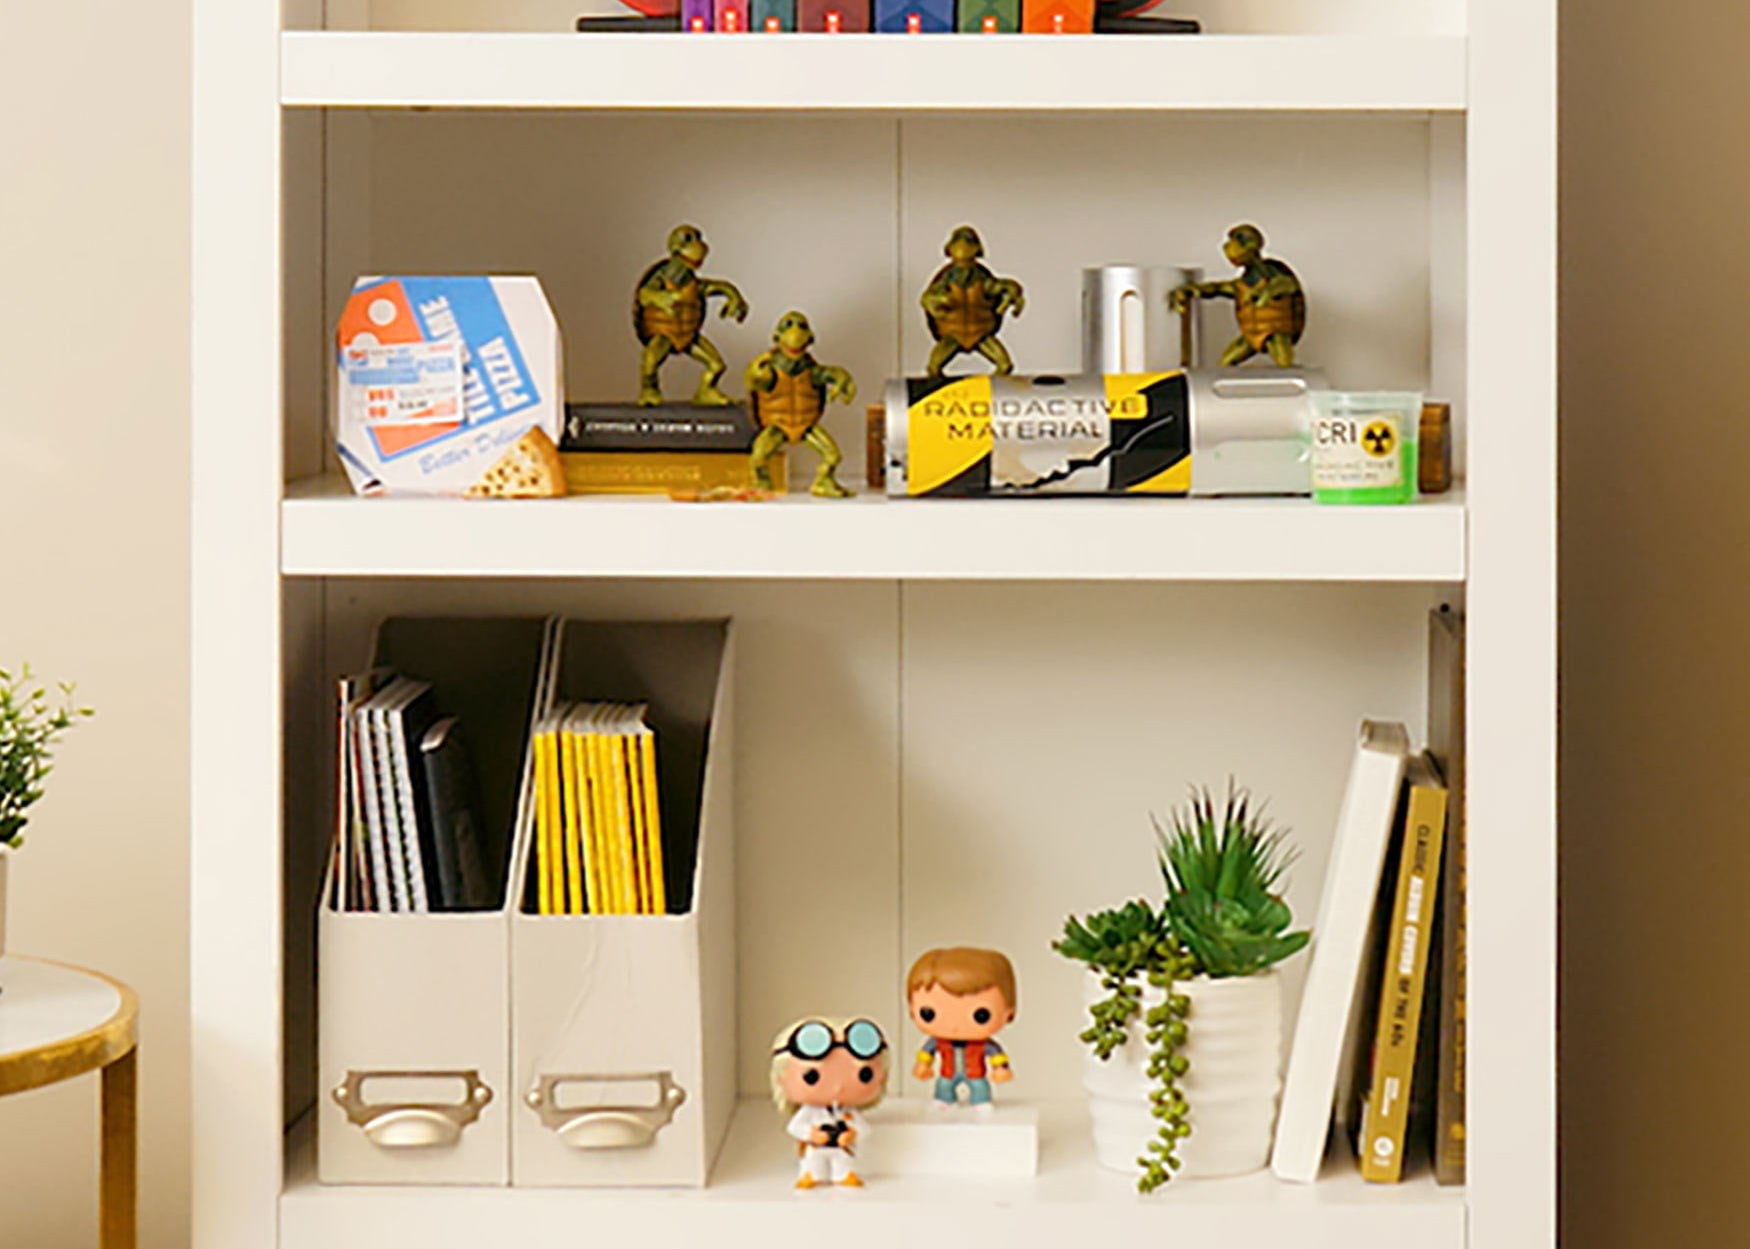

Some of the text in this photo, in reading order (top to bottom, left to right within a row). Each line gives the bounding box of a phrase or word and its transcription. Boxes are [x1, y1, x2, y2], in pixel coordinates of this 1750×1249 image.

[477, 336, 531, 411] PIZZA
[924, 396, 1140, 418] RADIOACTIVE
[947, 419, 1103, 440] MATERIAL
[1313, 421, 1357, 444] CRI
